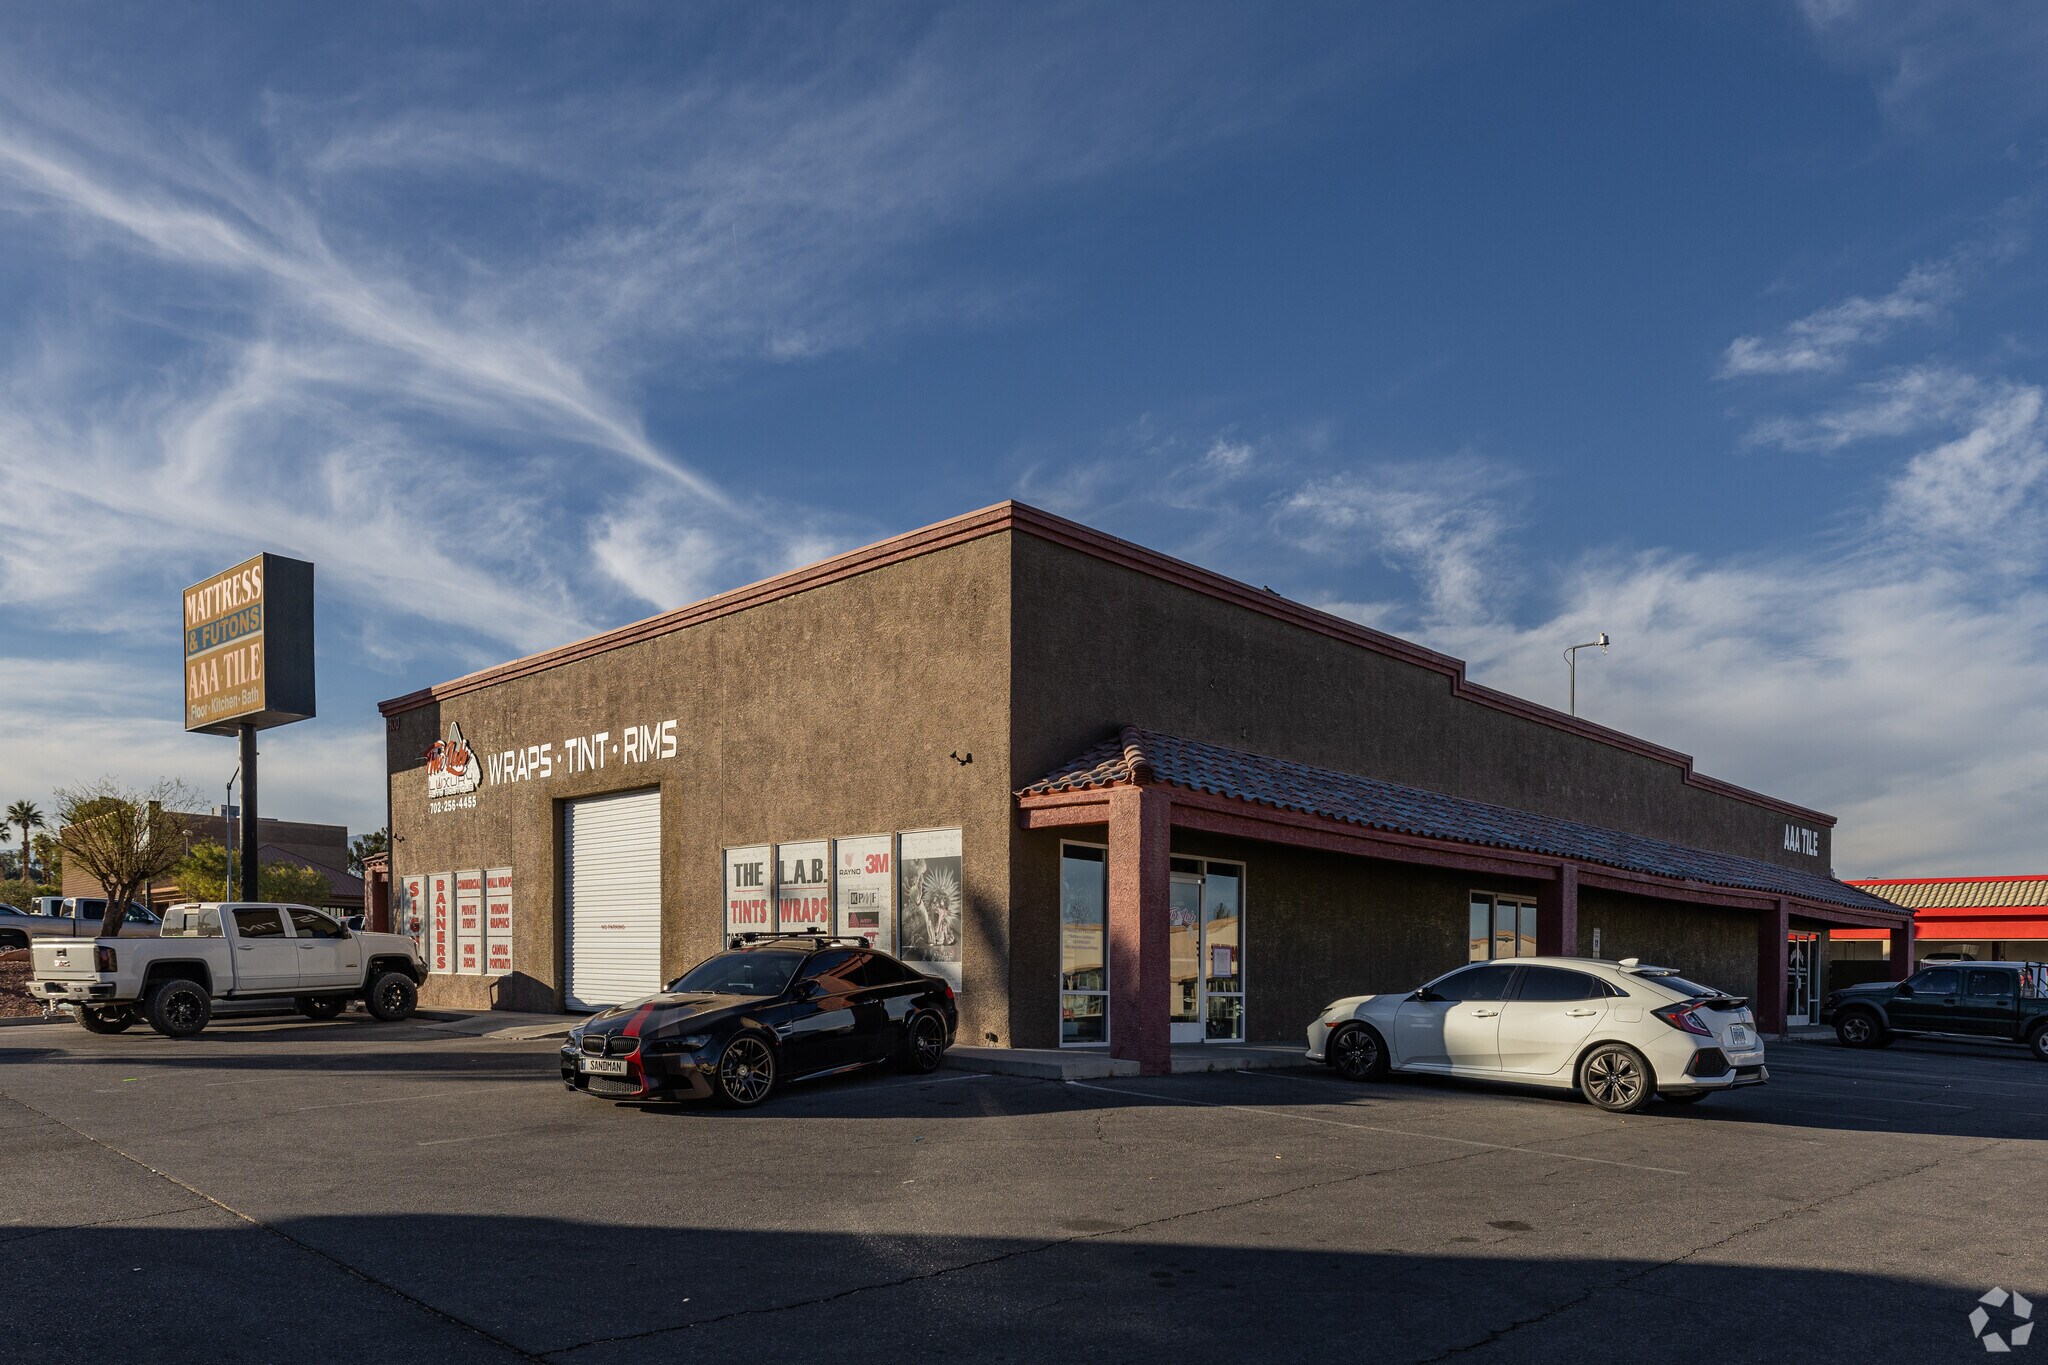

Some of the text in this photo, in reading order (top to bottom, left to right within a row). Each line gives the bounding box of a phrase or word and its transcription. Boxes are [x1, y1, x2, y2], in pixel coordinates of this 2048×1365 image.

[186, 565, 261, 627] MATTRESS
[189, 606, 260, 653] & FUTONS
[188, 642, 260, 701] AAA TILE
[190, 687, 259, 721] Floor Kitchen Bath
[488, 720, 678, 786] WRAPS TINT RIMS
[428, 772, 474, 791] LUXURY
[1784, 824, 1818, 857] AAA TILE
[734, 858, 828, 887] THE L.A.B.
[840, 868, 861, 876] RAYNO
[865, 853, 889, 874] 3M
[490, 904, 509, 914] WINDOW
[731, 897, 828, 924] TINTS WRAPS
[436, 880, 446, 970] BANNERS
[590, 1060, 622, 1072] SANDMAN
